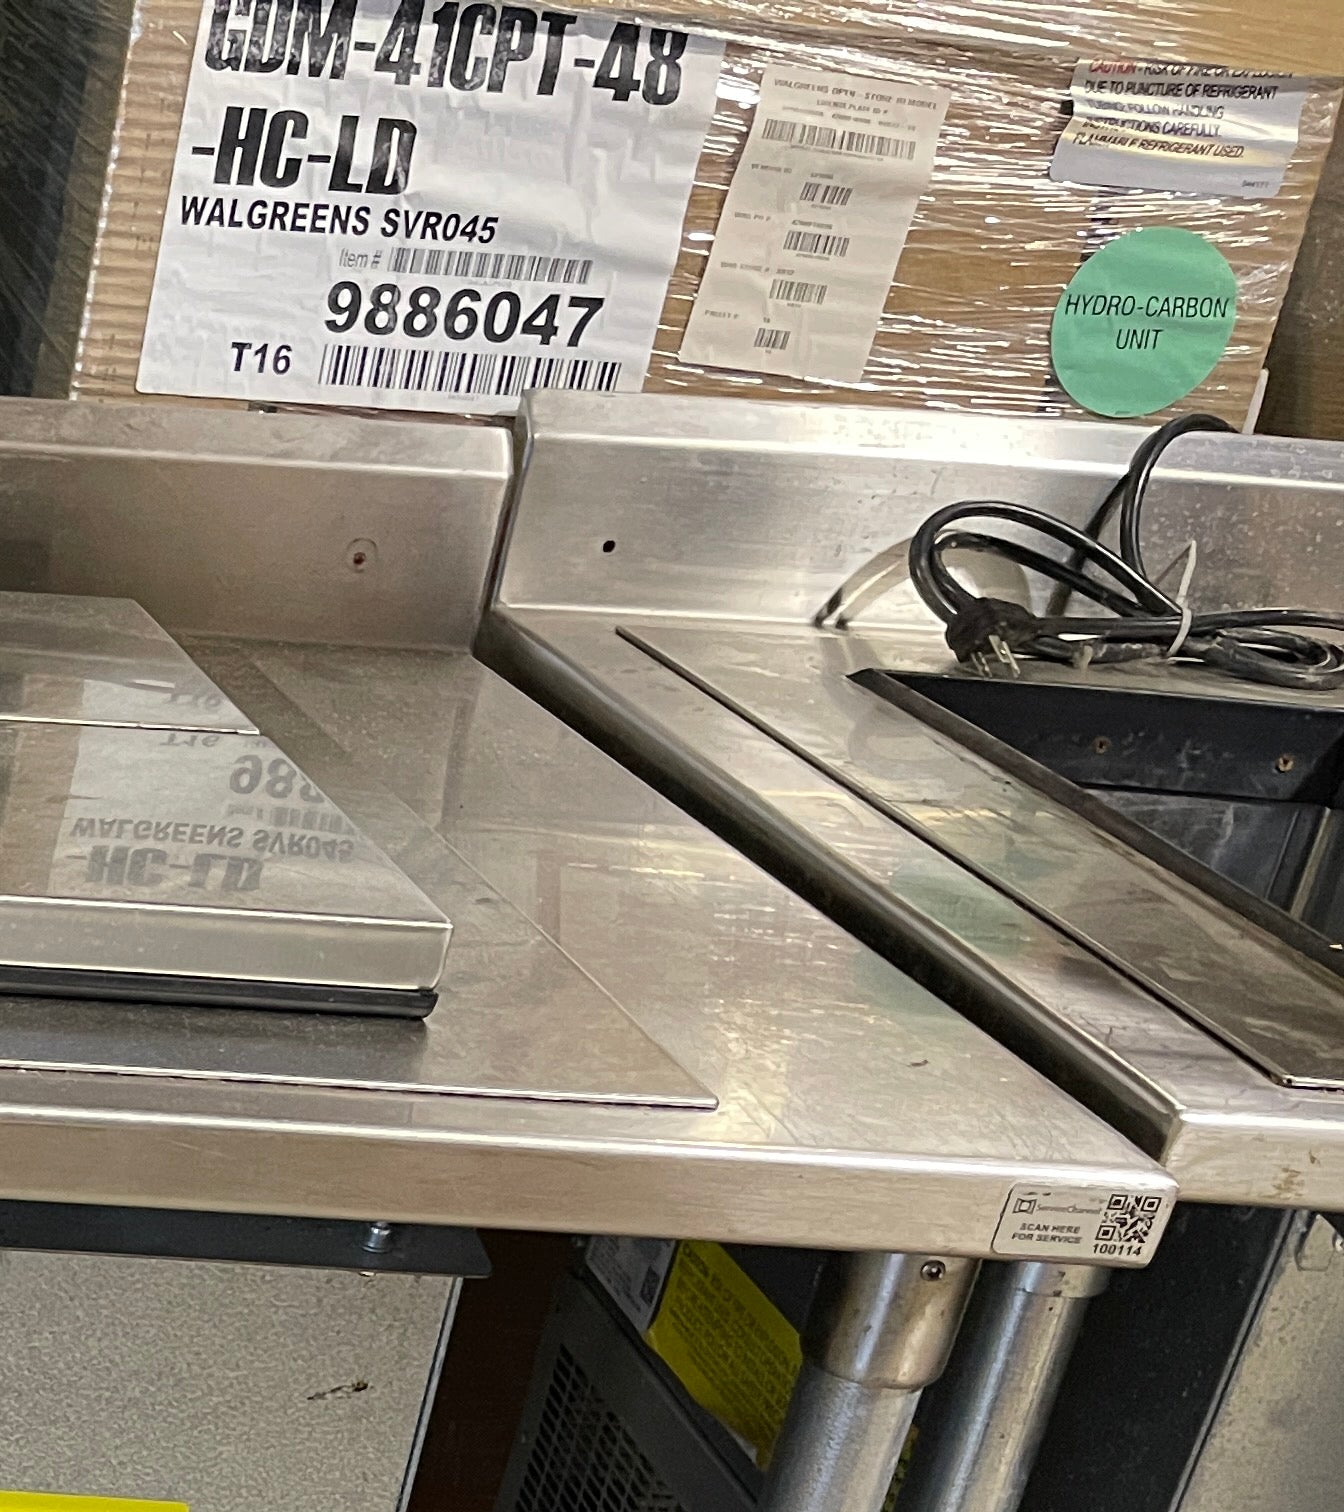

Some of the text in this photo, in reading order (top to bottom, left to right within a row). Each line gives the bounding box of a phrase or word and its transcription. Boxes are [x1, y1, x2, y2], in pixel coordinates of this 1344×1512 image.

[204, 0, 689, 106] GDM-41CPT-48
[1085, 80, 1279, 99] DUE TO PUNCTURE OF REFRIGERANT
[192, 105, 418, 196] -HC-LD
[1138, 139, 1213, 155] REFRIGERANT
[180, 195, 499, 246] WALGREENS SVR045
[339, 246, 383, 269] Item #
[324, 280, 605, 348] 9886047
[1065, 294, 1230, 318] HYDRO-CARBON
[1116, 329, 1164, 350] UNIT
[231, 341, 294, 375] T16
[1012, 1232, 1082, 1244] FOR SERVICE
[1020, 1222, 1081, 1234] SCAN HERE
[1093, 1243, 1142, 1256] 100114
